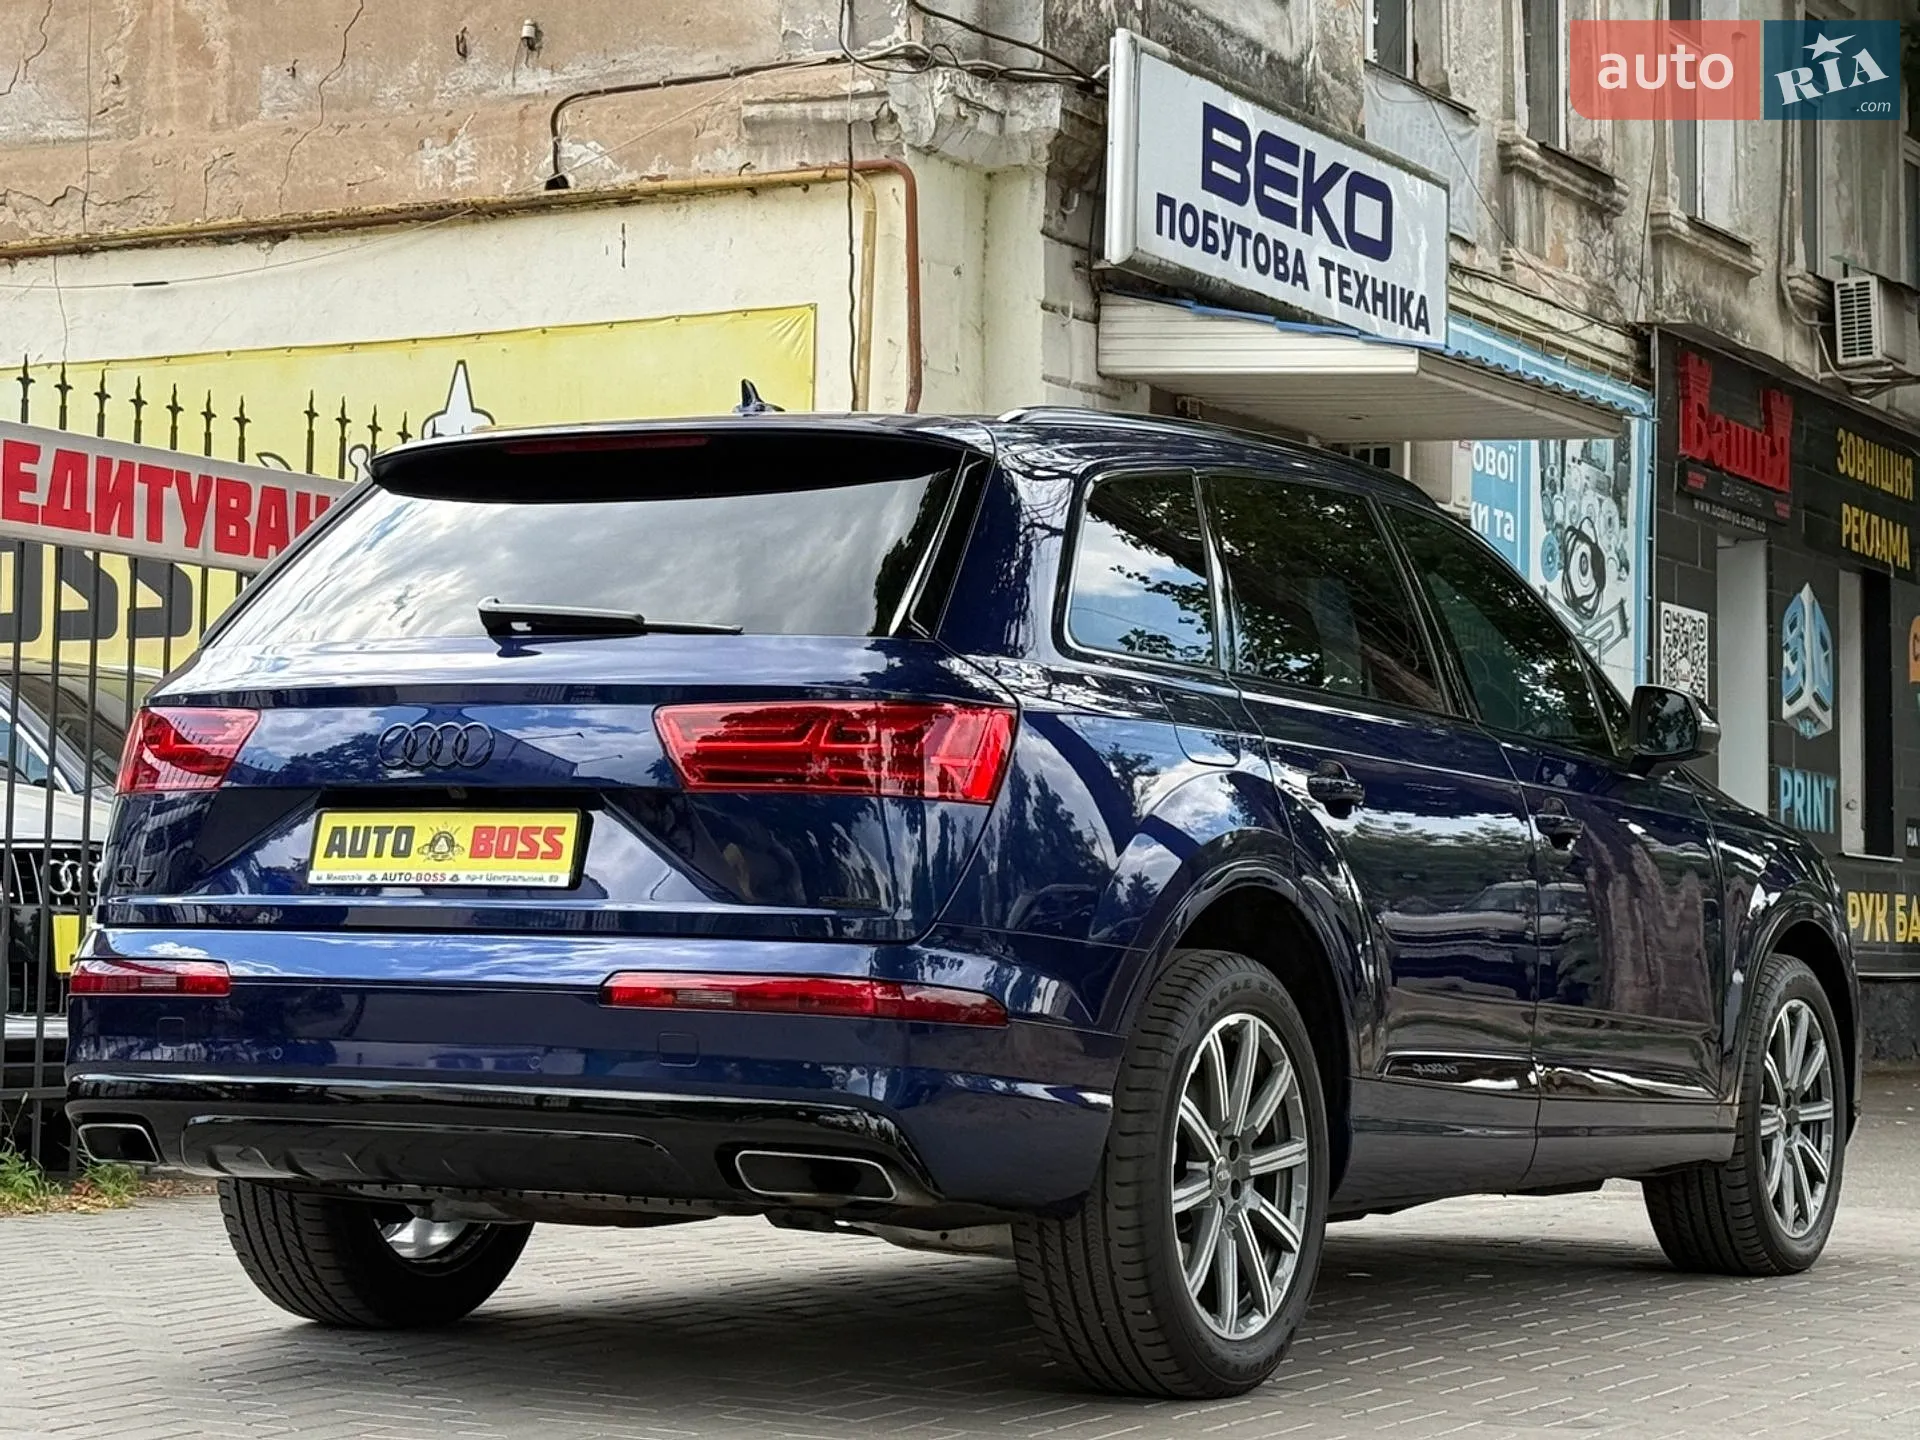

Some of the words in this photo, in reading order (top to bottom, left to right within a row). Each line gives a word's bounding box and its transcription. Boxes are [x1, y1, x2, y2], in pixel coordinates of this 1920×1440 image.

[1201, 101, 1394, 263] BEKO
[1156, 192, 1310, 291] ПОБУТОВА
[1319, 256, 1431, 336] ТЕХНІКА
[1837, 427, 1914, 501] ЗОВНІШНЯ
[1493, 508, 1515, 543] та
[1842, 502, 1911, 571] РЕКЛАМА
[1780, 767, 1836, 834] PRINT
[117, 864, 157, 888] Q7
[323, 826, 416, 859] AUTO
[469, 826, 566, 860] BOSS
[381, 872, 447, 882] AUTO-BOSS
